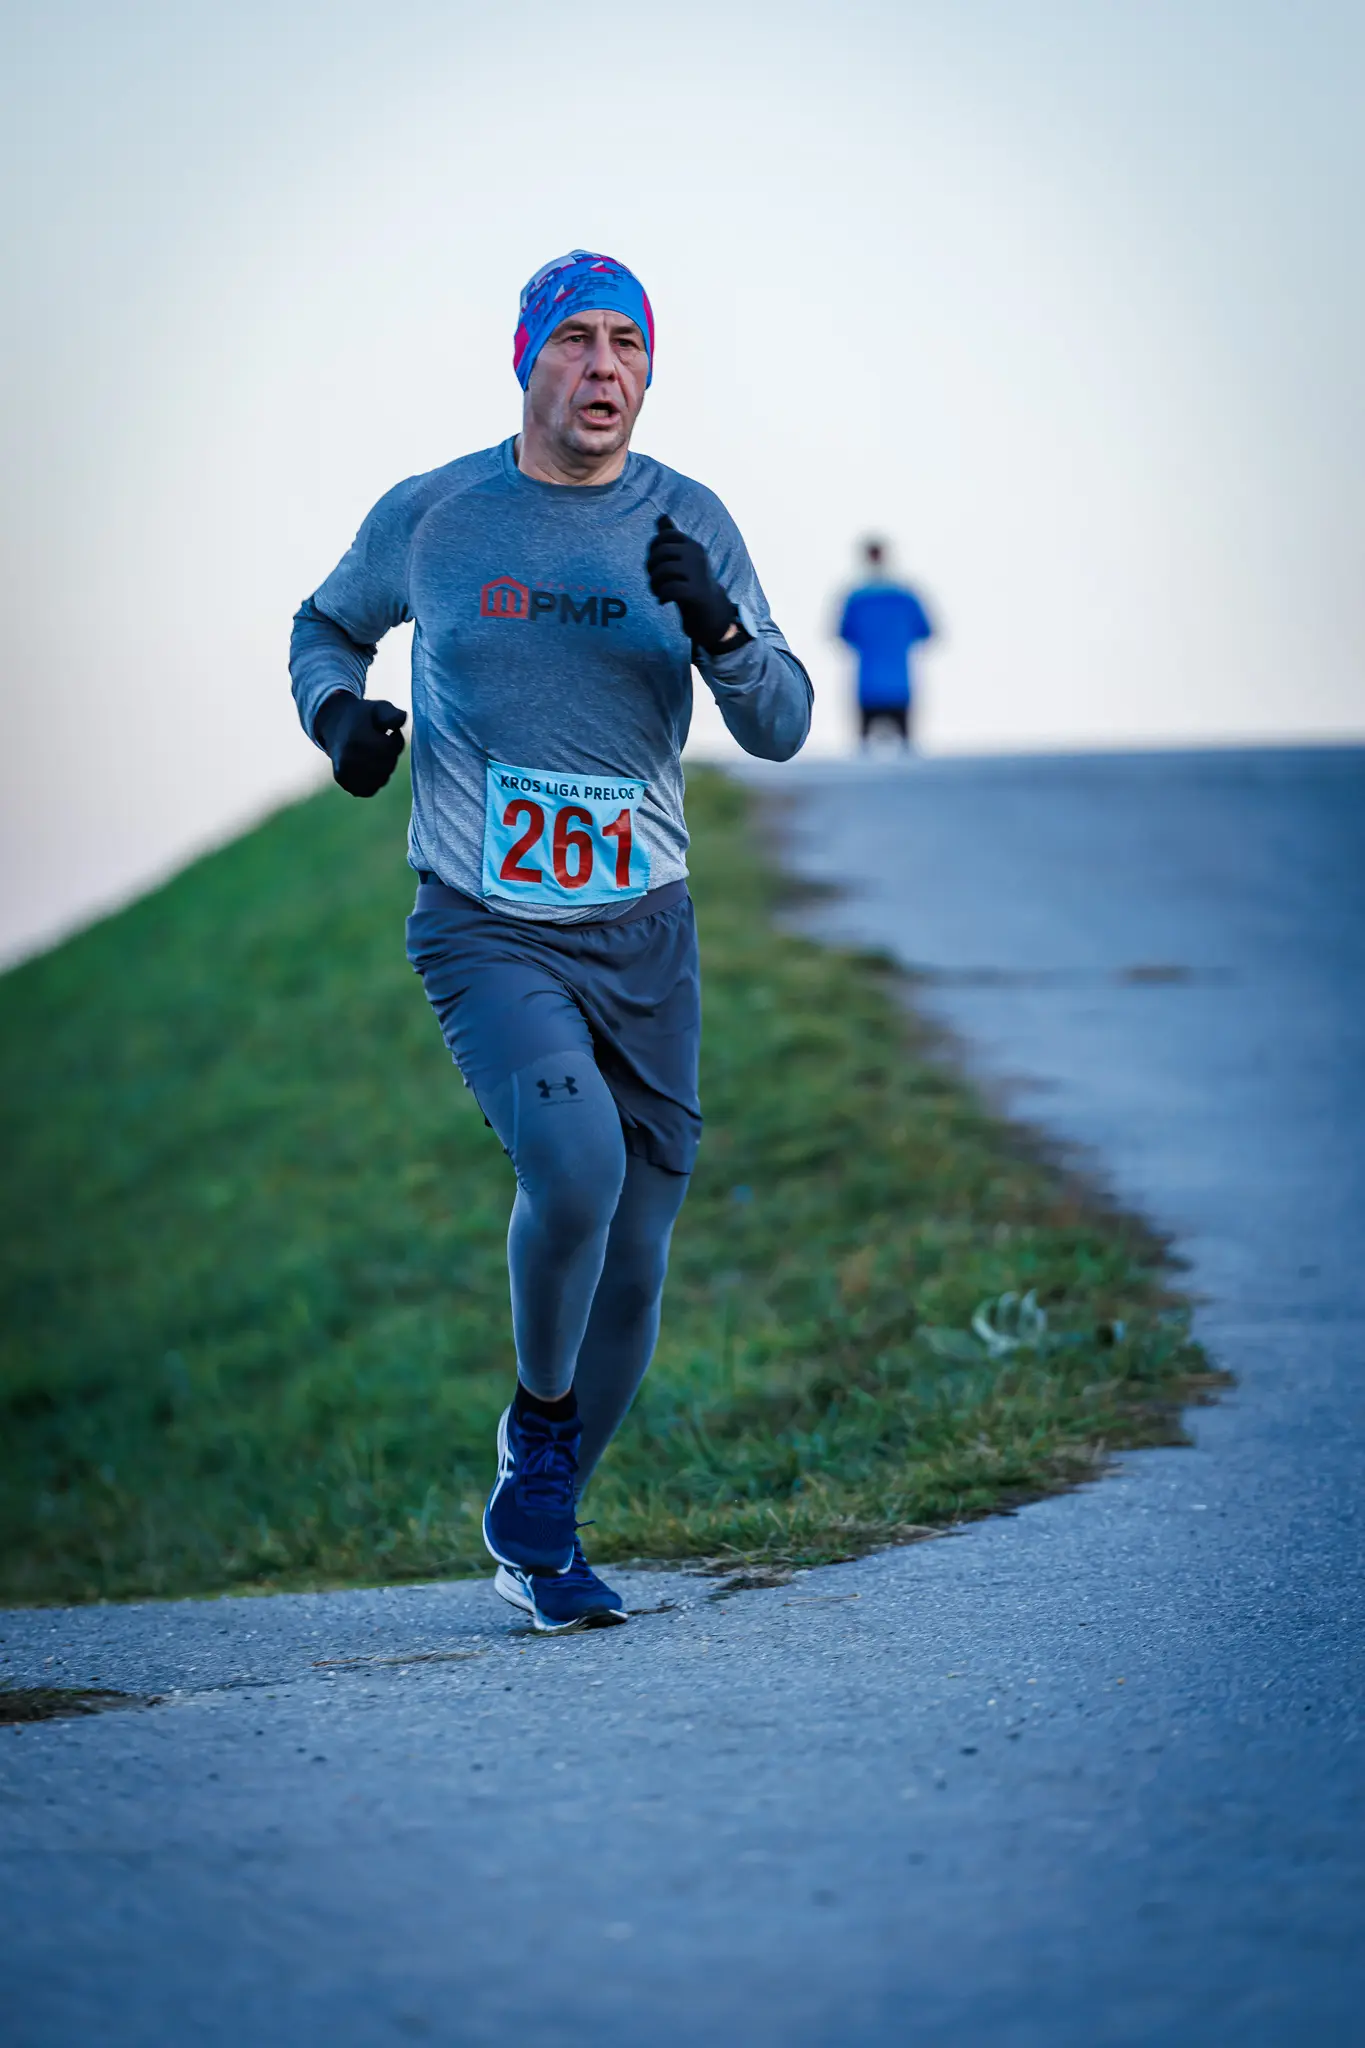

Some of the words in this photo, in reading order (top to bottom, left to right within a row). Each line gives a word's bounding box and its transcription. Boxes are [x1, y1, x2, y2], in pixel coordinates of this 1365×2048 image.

[529, 590, 627, 627] PMP
[500, 774, 541, 793] KROS
[545, 781, 580, 799] LIGA
[500, 798, 632, 889] 261
